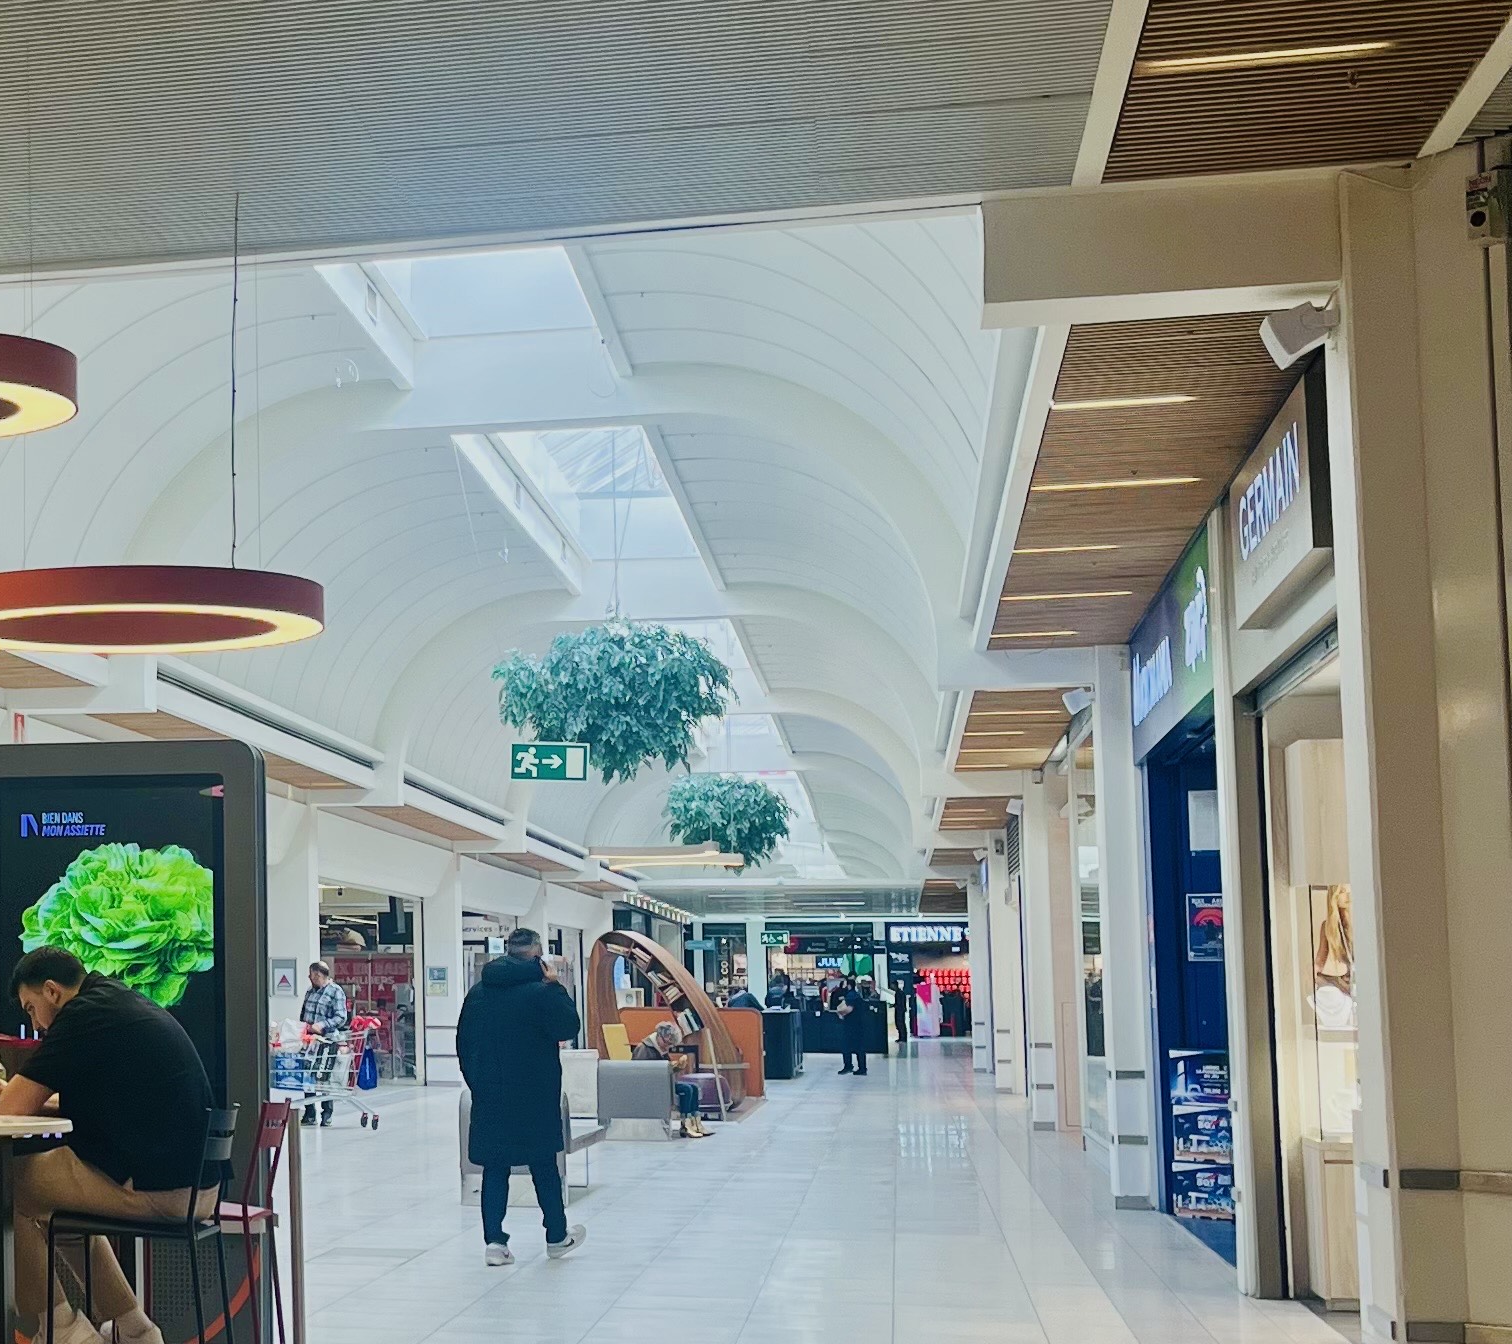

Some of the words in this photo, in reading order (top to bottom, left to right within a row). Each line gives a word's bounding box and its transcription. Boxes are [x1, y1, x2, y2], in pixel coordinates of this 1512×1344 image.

[1239, 421, 1300, 561] GERMAIN
[41, 812, 61, 824] BIEN
[61, 811, 84, 824] DANS
[41, 824, 63, 836] MON
[64, 824, 106, 836] ASSIETTE
